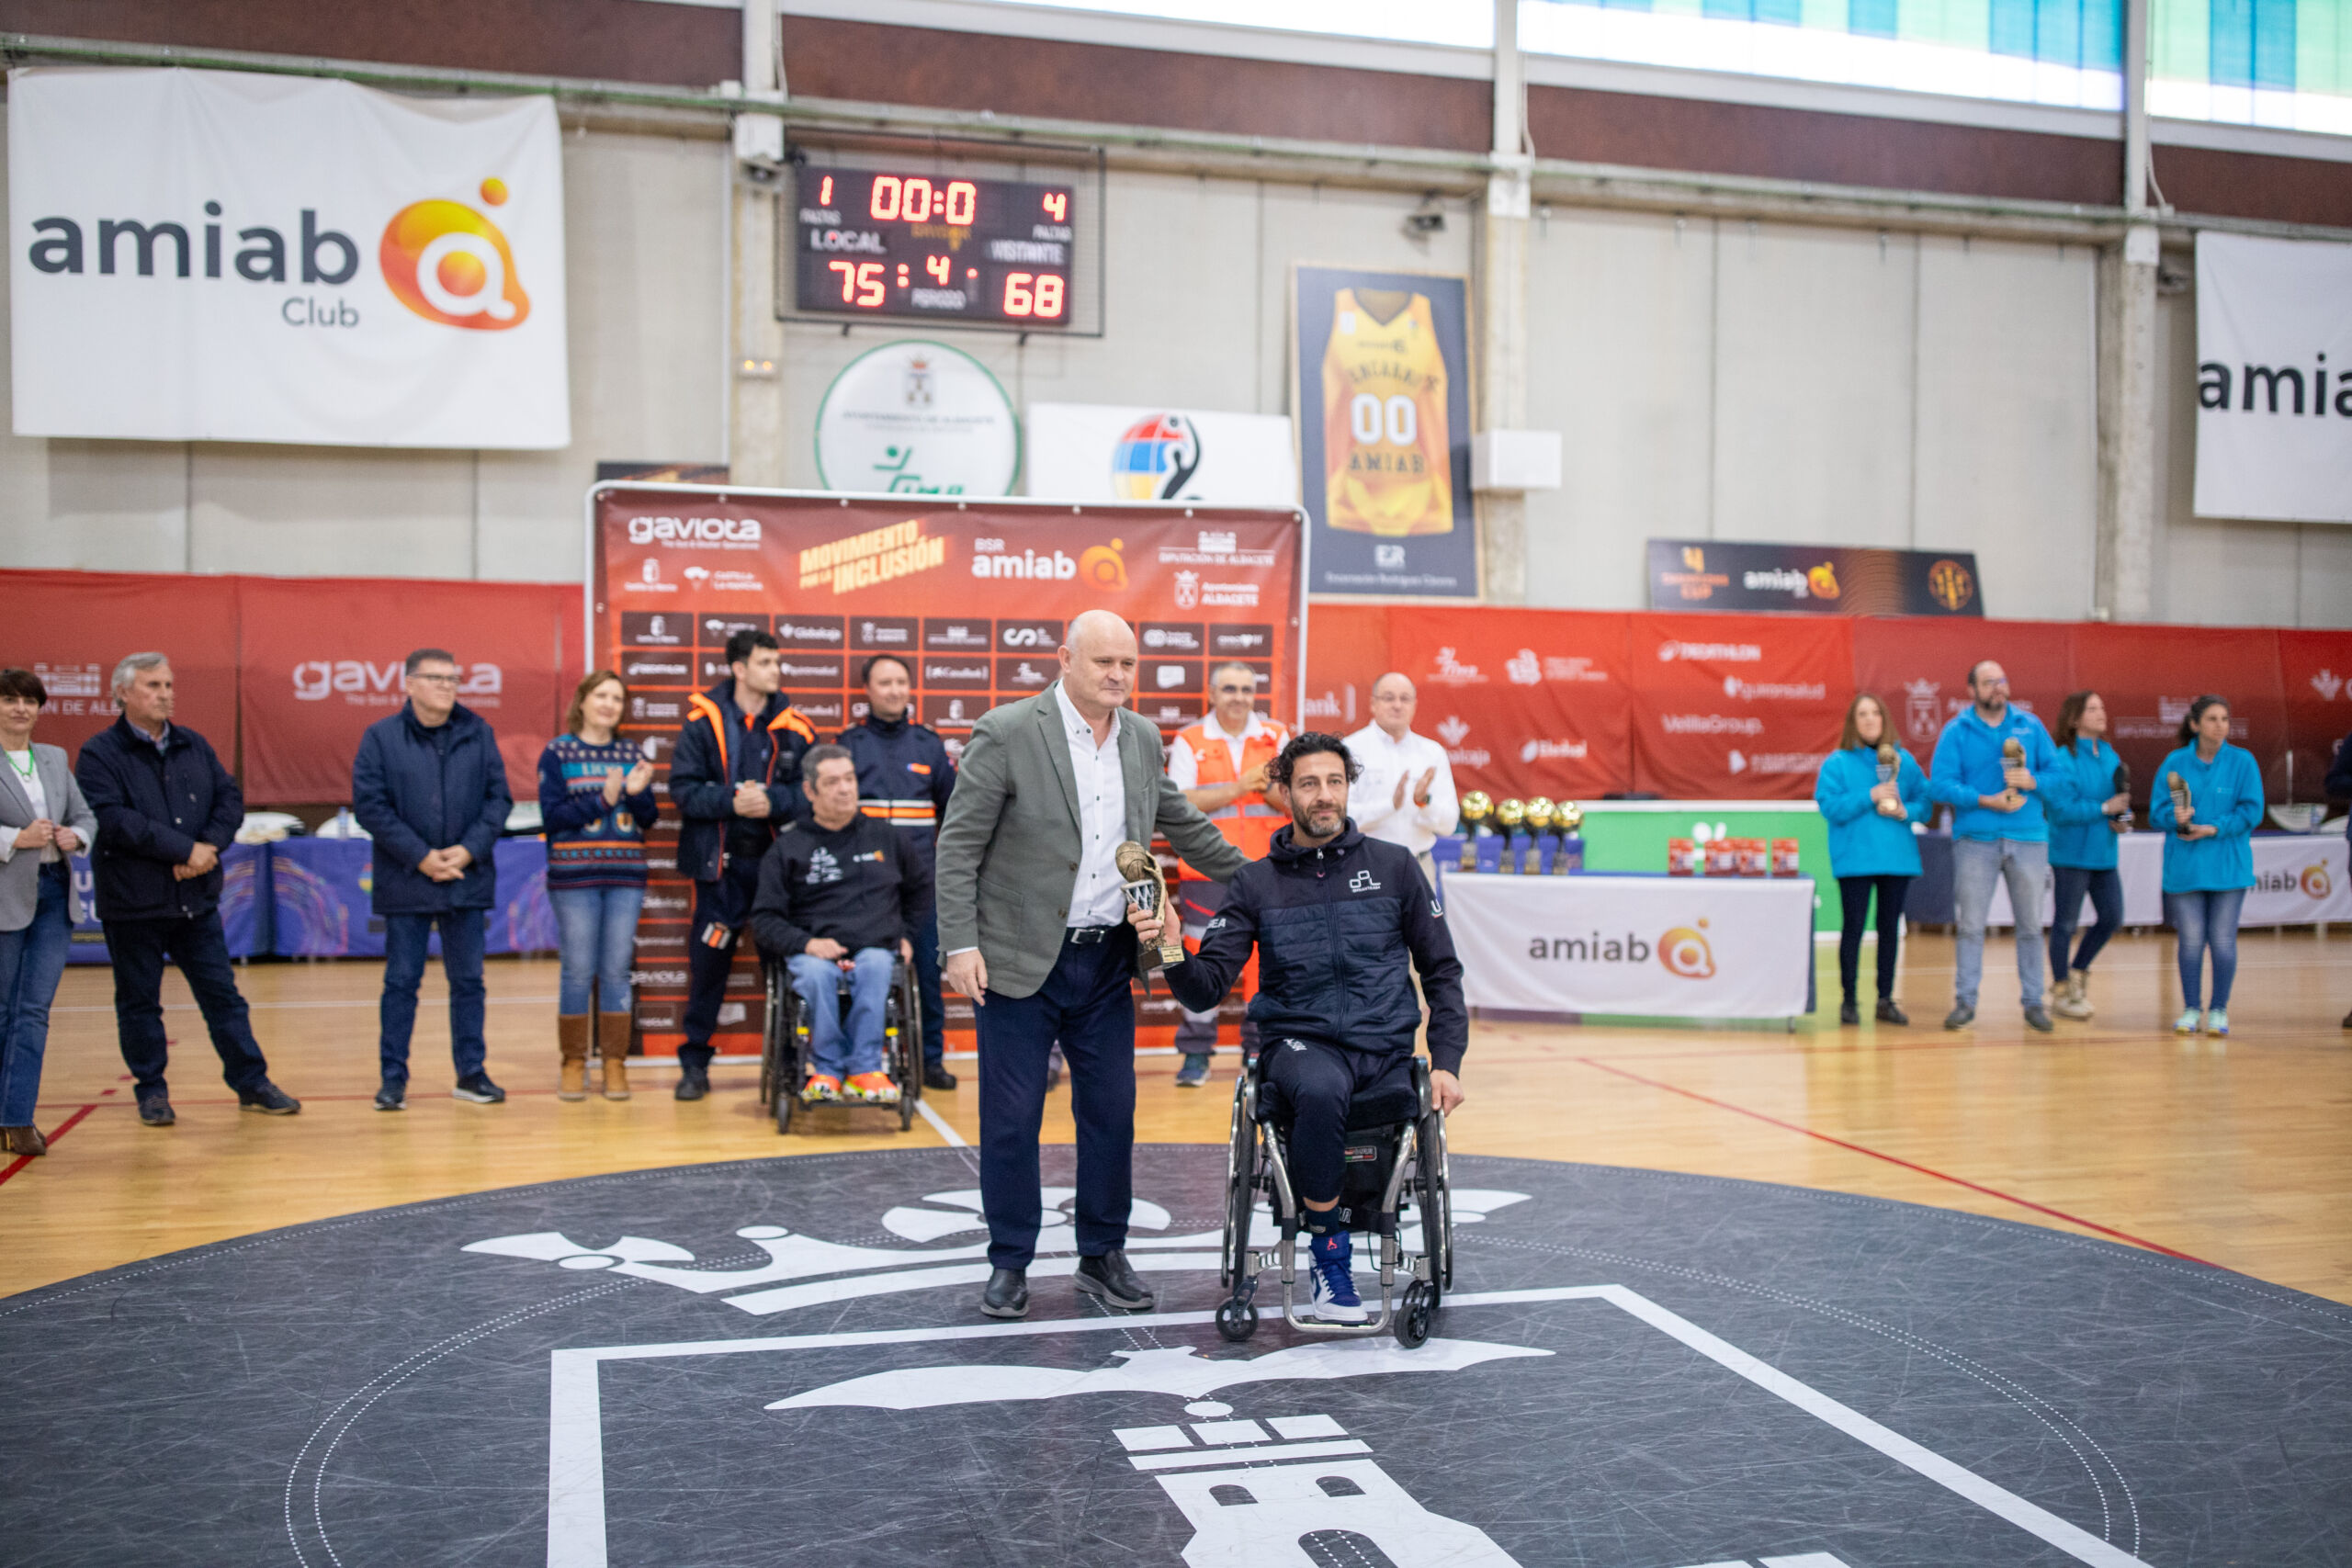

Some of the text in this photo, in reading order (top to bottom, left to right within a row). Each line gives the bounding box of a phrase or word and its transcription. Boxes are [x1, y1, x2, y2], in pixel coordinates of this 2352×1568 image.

[820, 176, 833, 205] 1
[870, 176, 977, 225] 00:0
[1043, 193, 1067, 221] 4
[28, 200, 359, 287] amiab
[810, 229, 887, 254] LOCAL
[829, 261, 886, 308] 75
[926, 255, 951, 287] 4
[1003, 272, 1065, 318] 68
[281, 296, 359, 328] Club
[1351, 393, 1418, 446] 00
[628, 516, 763, 545] gaviota
[974, 537, 1005, 552] BSR
[799, 519, 919, 575] MOVIMIENTO
[832, 535, 944, 595] INCLUSIÓN
[971, 549, 1077, 581] amiab
[1744, 568, 1808, 591] amiab
[1529, 932, 1650, 963] amiab
